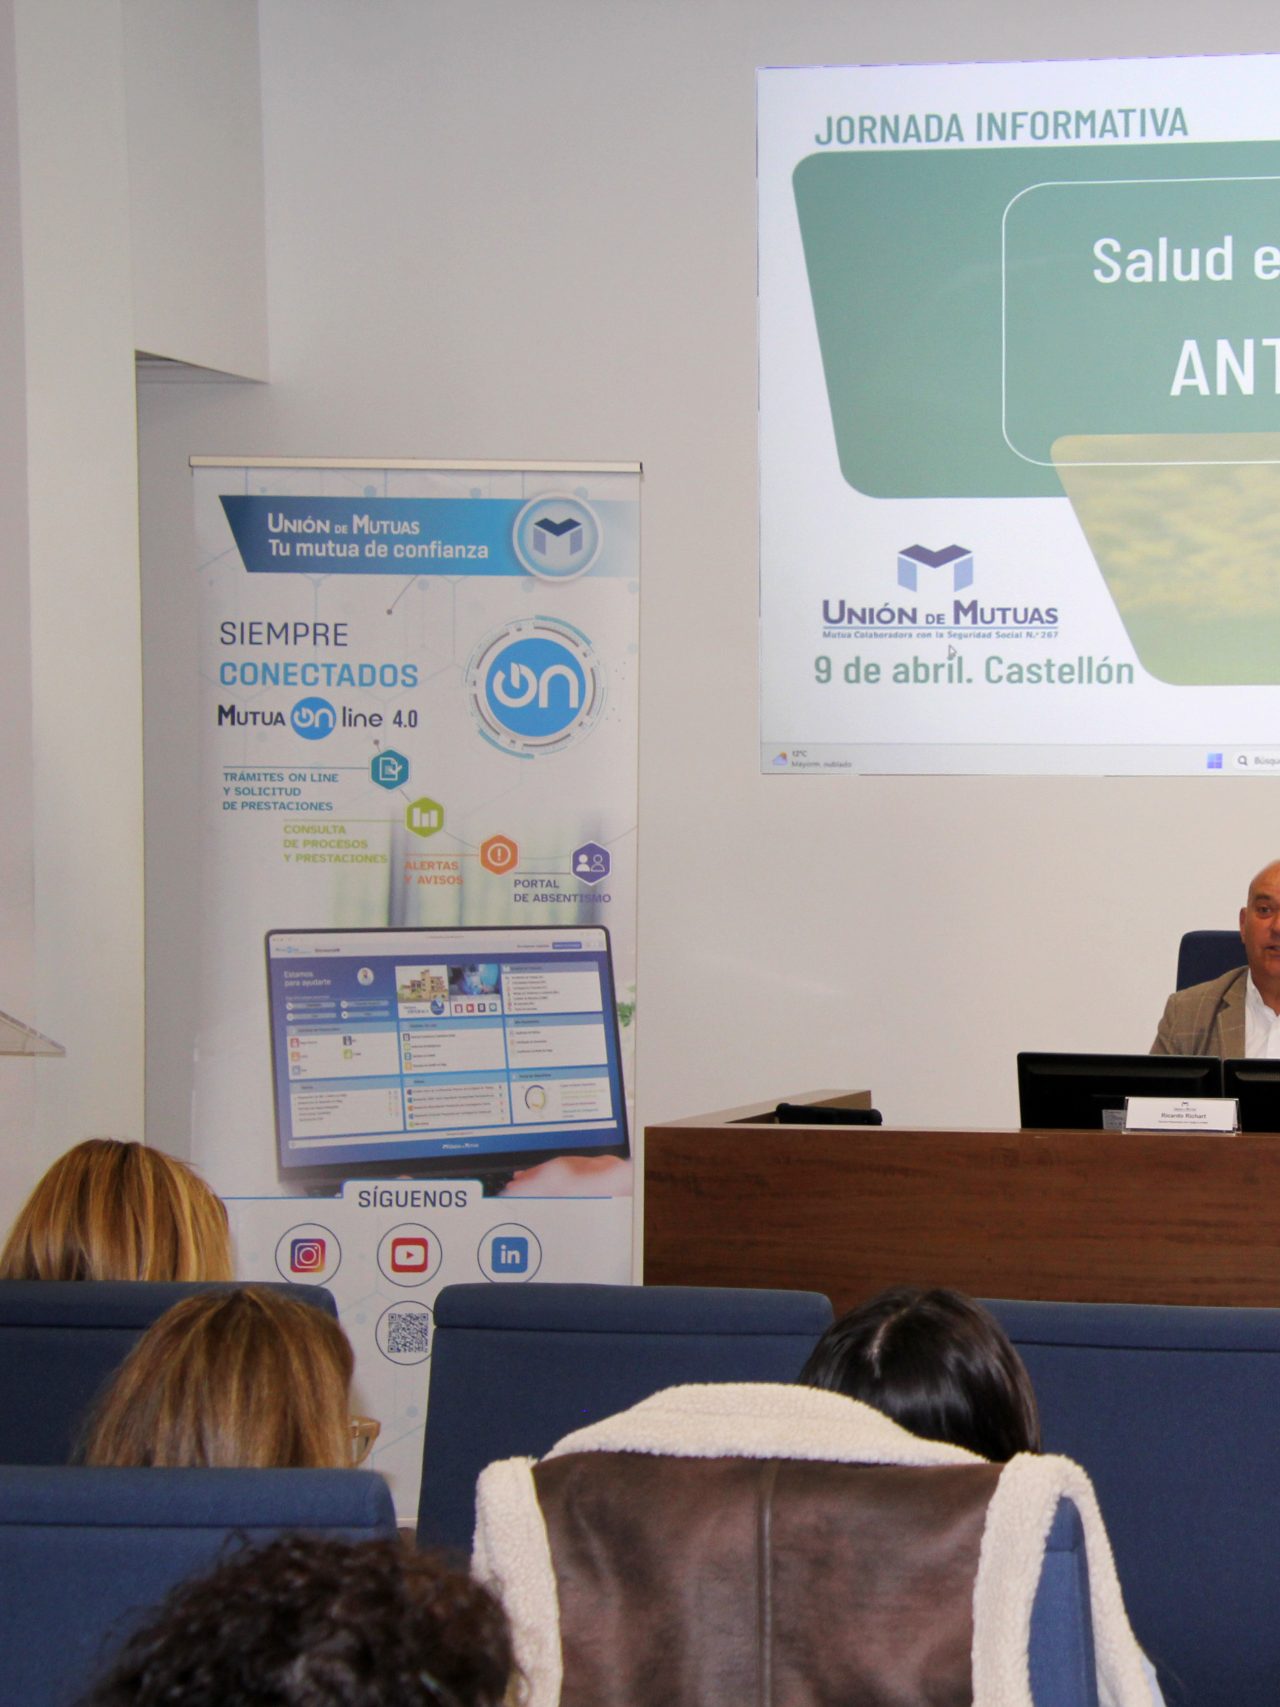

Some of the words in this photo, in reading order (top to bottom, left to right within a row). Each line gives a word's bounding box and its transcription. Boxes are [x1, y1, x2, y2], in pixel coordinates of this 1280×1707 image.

[814, 113, 964, 146] JORNADA
[976, 107, 1189, 142] INFORMATIVA
[1092, 234, 1233, 284] Salud
[267, 512, 330, 534] UNIÓN
[334, 524, 348, 534] DE
[352, 514, 420, 535] MUTUAS
[268, 539, 290, 556] Tu
[296, 542, 359, 557] mutua
[364, 540, 388, 557] de
[393, 540, 489, 559] confianza
[822, 599, 917, 625] UNIÓN
[925, 613, 945, 625] DE
[953, 599, 1059, 625] MUTUAS
[220, 621, 348, 646] SIEMPRE
[823, 631, 852, 639] Mutua
[854, 631, 913, 639] Colaboradora
[947, 631, 992, 640] Seguridad
[996, 631, 1022, 639] Social
[219, 661, 418, 688] CONECTADOS
[814, 655, 832, 684] 9
[843, 655, 881, 684] de
[892, 655, 973, 684] abril.
[984, 655, 1134, 684] Castellón
[217, 704, 286, 726] MUTUA
[342, 705, 384, 727] line
[392, 709, 418, 728] 4.0
[223, 771, 284, 783] TRÁMITES
[288, 773, 307, 782] ON
[311, 773, 339, 783] LINE
[223, 787, 231, 796] Y
[234, 787, 302, 797] SOLICITUD
[223, 801, 237, 811] DE
[241, 801, 333, 811] PRESTACIONES
[283, 824, 346, 834] CONSULTA
[283, 839, 298, 849] DE
[302, 839, 368, 849] PROCESOS
[283, 854, 292, 863] Y
[295, 853, 388, 864] PRESTACIONES
[404, 861, 459, 871] ALERTAS
[404, 875, 412, 885] Y
[417, 875, 464, 885] AVISOS
[513, 879, 560, 889] PORTAL
[513, 893, 530, 903] DE
[532, 893, 612, 903] ABSENTISMO
[358, 1185, 468, 1209] SÍGUENOS
